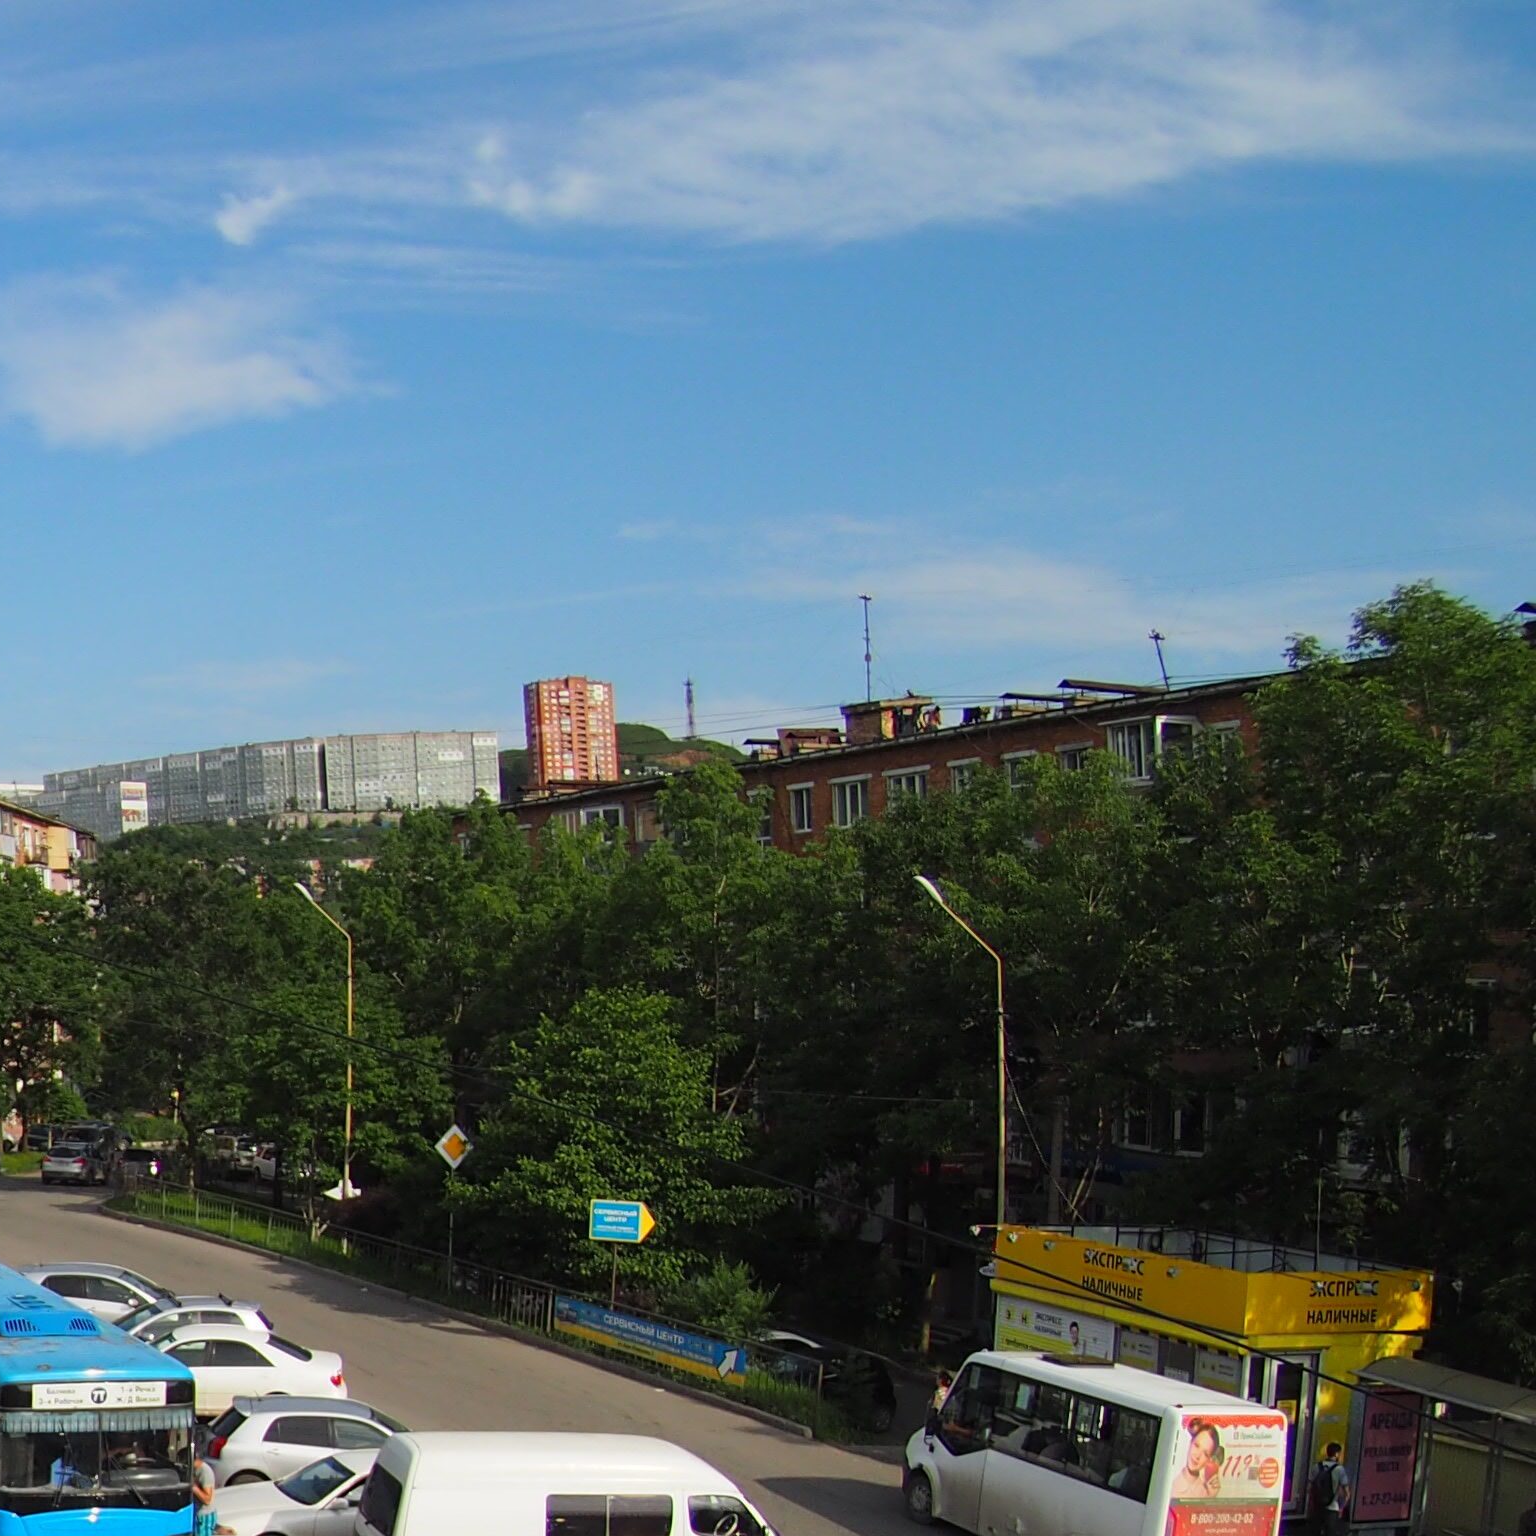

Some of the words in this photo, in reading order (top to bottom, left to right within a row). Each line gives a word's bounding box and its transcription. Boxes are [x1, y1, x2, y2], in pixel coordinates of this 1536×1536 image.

[1082, 1275, 1143, 1301] НАЛИЧНЫЕ
[1307, 1309, 1377, 1324] НАЛИЧНЫЕ
[603, 1314, 655, 1337] СЕРВИСНЫЙ
[656, 1329, 685, 1345] ЦЕНТР
[1370, 1411, 1413, 1430] АРЕНДА
